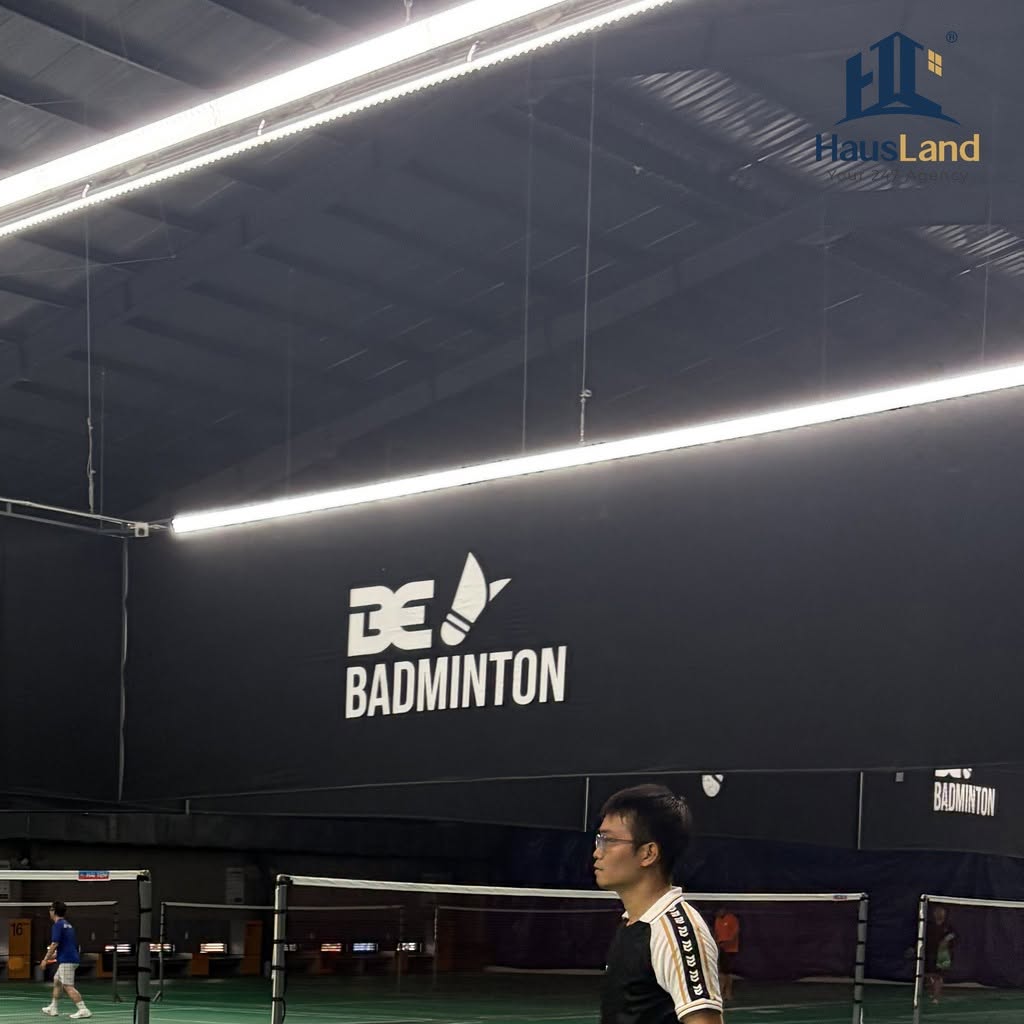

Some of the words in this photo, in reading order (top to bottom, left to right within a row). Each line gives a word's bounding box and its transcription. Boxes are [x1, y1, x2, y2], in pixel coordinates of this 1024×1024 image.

[347, 579, 435, 657] BE
[345, 645, 567, 719] BADMINTON
[933, 781, 996, 817] BADMINTON
